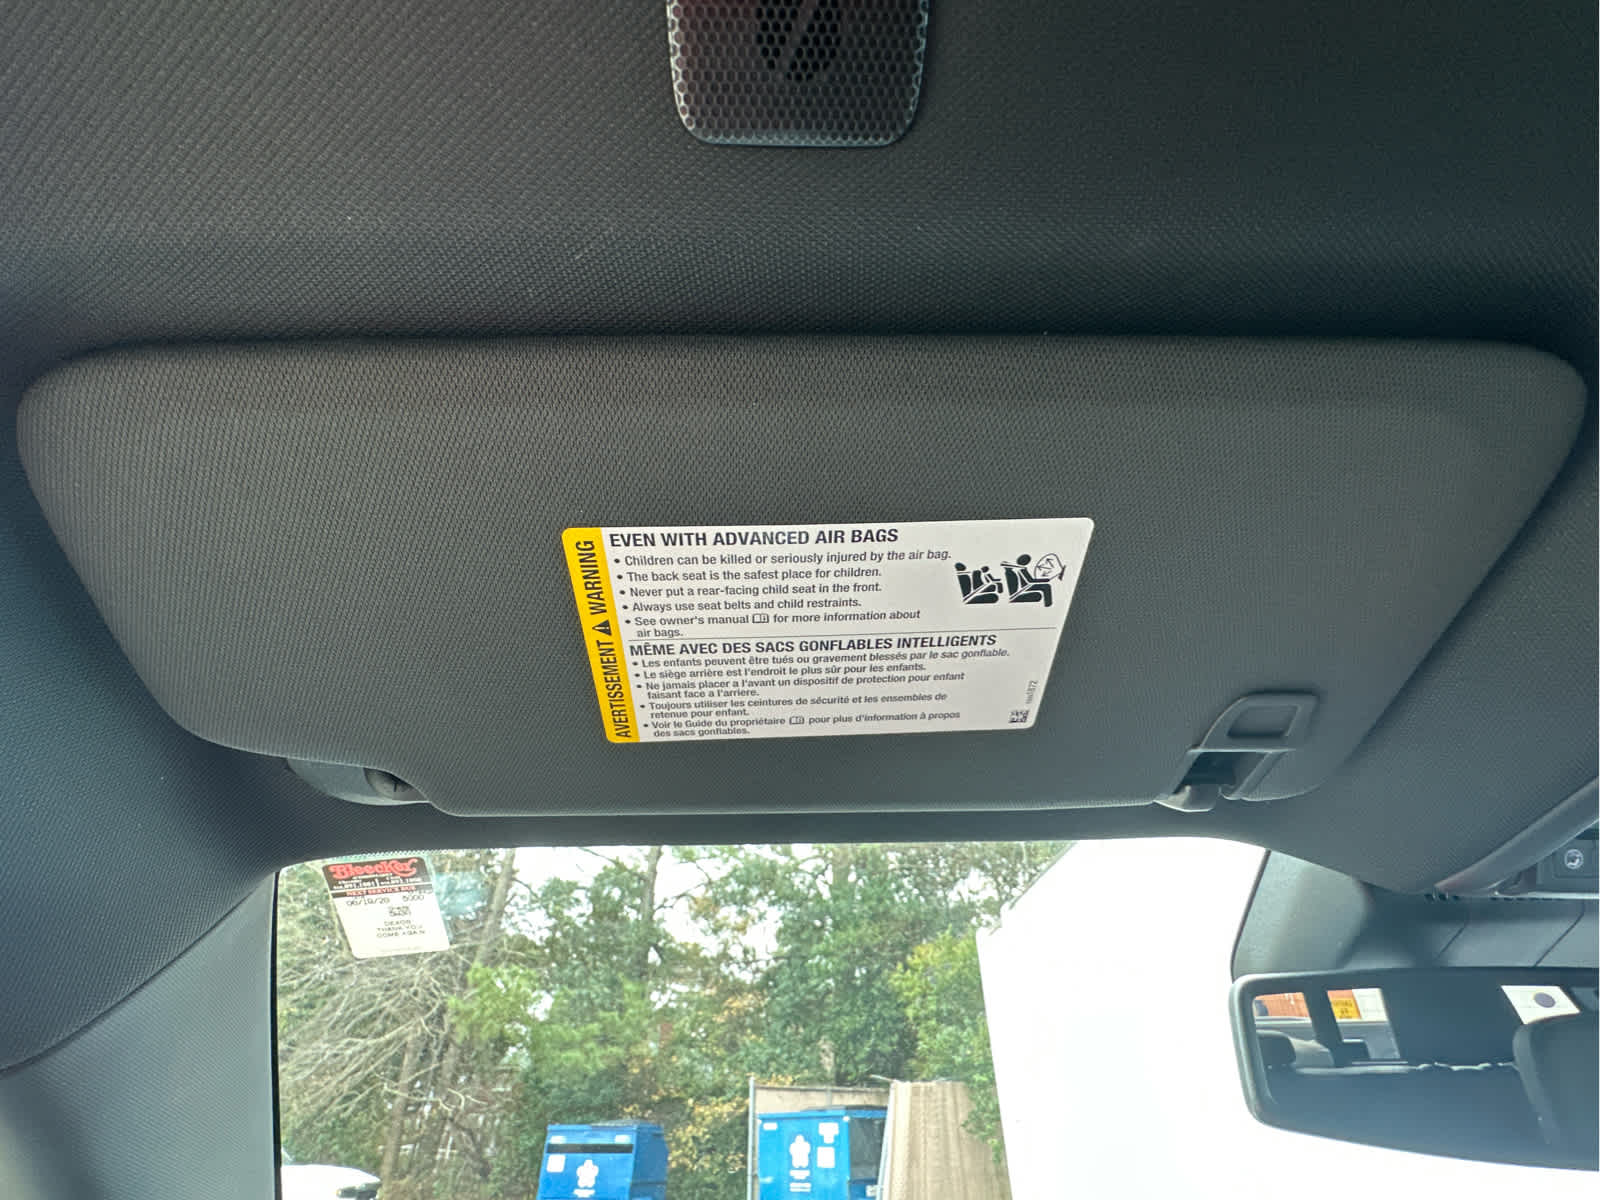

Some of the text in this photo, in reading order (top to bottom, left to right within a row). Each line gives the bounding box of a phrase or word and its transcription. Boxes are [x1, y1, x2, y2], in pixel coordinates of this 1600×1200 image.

[610, 528, 898, 547] EVEN WITH ADVANCED AIR BAGS
[625, 549, 951, 566] Children can be killed or seriously injured by the air bag.
[576, 540, 607, 615] WARNING
[627, 567, 881, 582] The back seat is the safest place for children.
[631, 587, 662, 597] Never
[666, 587, 684, 597] put
[697, 585, 759, 597] rear-facing
[762, 584, 788, 594] child
[792, 585, 816, 594] seat
[819, 583, 829, 593] in
[832, 583, 850, 592] the
[853, 582, 881, 592] front.
[633, 598, 862, 613] Always use seat belts and child restraints.
[635, 610, 920, 626] See owner's manual for more information about
[637, 628, 683, 638] air bags.
[630, 635, 996, 656] MÊME AVEC DES SACS GONFLABLES INTELLIGENTS
[642, 659, 660, 668] Les
[663, 658, 702, 667] enfants
[705, 657, 746, 666] peuvent
[772, 655, 794, 664] tués
[812, 653, 866, 664] gravement
[869, 652, 907, 662] blessés
[910, 651, 927, 661] par
[929, 650, 938, 659] le
[940, 651, 958, 659] sac
[961, 648, 1010, 659] gonflable.
[644, 663, 926, 680] Le siège arrière est l'endroit le plus sûr pour les enfants.
[596, 640, 632, 738] AVERTISSEMENT
[662, 681, 696, 690] jamais
[699, 680, 729, 689] placer
[742, 678, 775, 688] l'avant
[793, 676, 838, 686] dispositif
[856, 674, 906, 684] protection
[908, 673, 929, 683] pour
[933, 672, 964, 680] enfant
[648, 690, 682, 700] faisant
[684, 690, 705, 698] face
[649, 701, 692, 711] Toujours
[694, 700, 727, 709] utiliser
[730, 699, 745, 707] les
[748, 698, 793, 707] ceintures
[796, 697, 808, 705] de
[810, 695, 850, 704] sécurité
[852, 695, 861, 703] et
[864, 695, 878, 703] les
[881, 693, 932, 702] ensembles
[651, 708, 749, 719] retenue pour enfant.
[652, 720, 671, 729] Voir
[674, 720, 683, 728] le
[685, 719, 713, 728] Guide
[715, 719, 728, 727] du
[731, 717, 785, 728] propriétaire
[809, 716, 831, 725] pour
[833, 715, 853, 724] plus
[856, 712, 917, 722] d'information
[929, 711, 960, 721] propos
[673, 729, 695, 737] sacs
[368, 887, 398, 895] SERVICE
